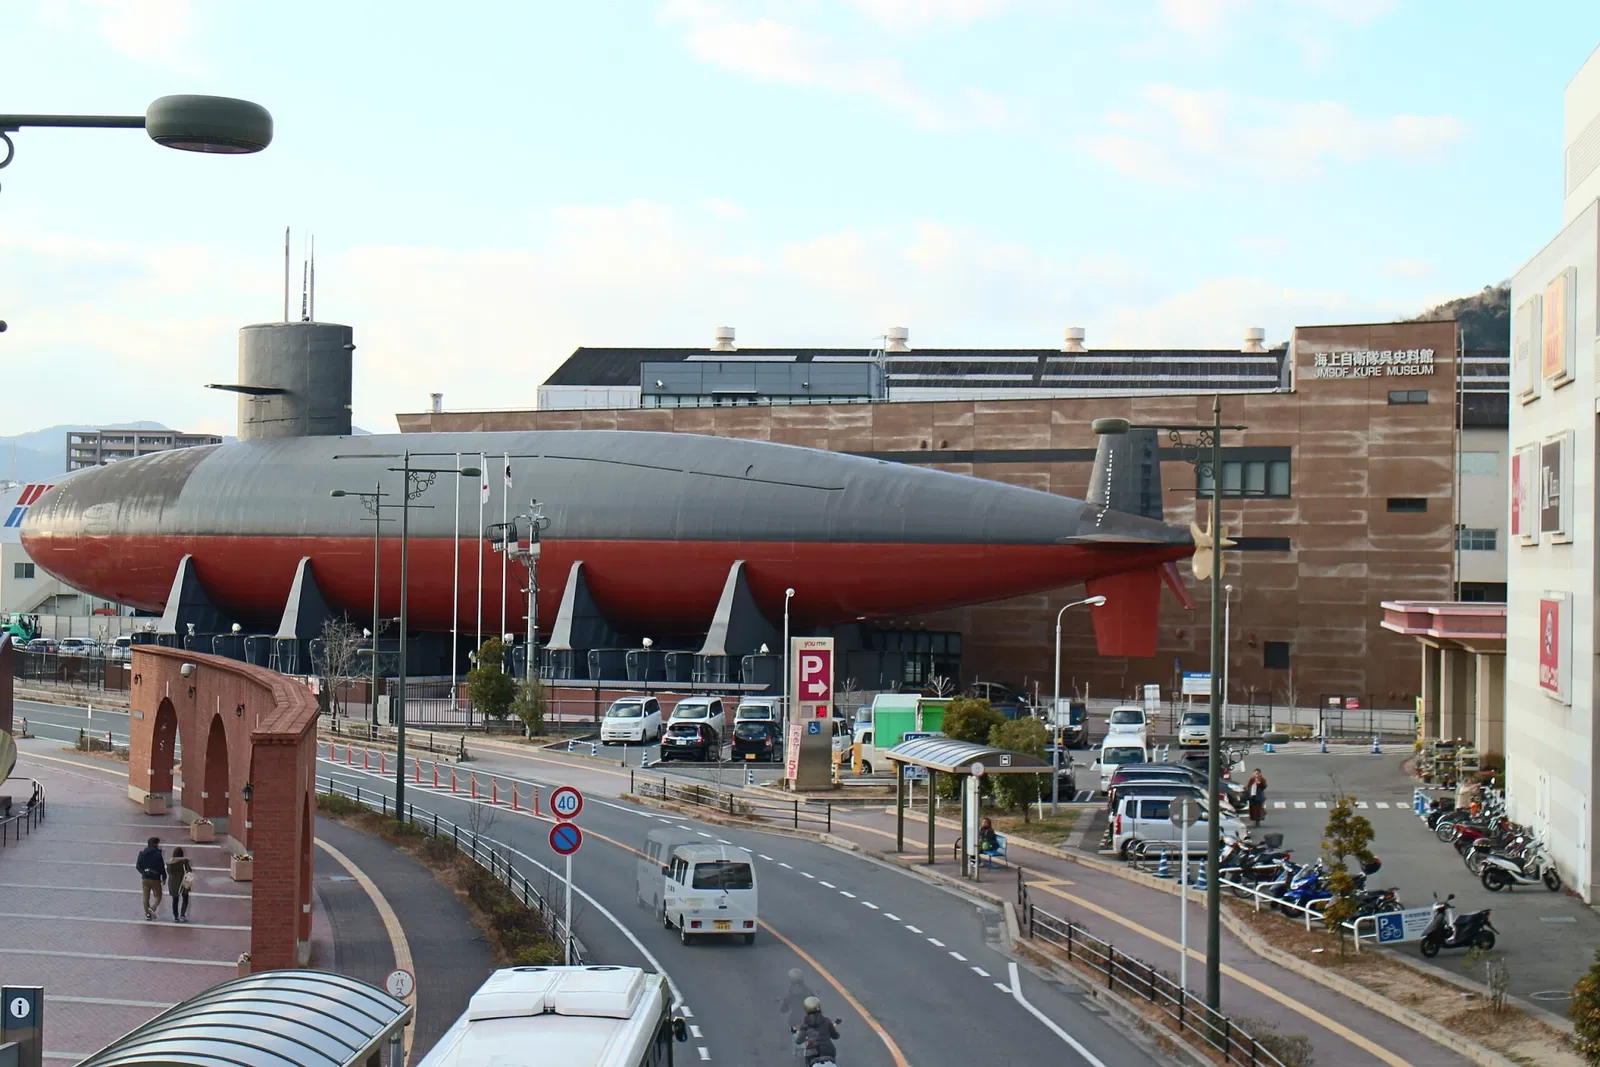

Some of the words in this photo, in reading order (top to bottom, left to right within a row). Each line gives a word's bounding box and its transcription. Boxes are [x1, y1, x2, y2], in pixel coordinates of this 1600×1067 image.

[1314, 349, 1434, 367] 海上自衛隊呉史料館
[1314, 367, 1349, 378] JMSDF
[1353, 366, 1382, 377] KURE
[1386, 365, 1434, 376] MUSEUM
[801, 655, 823, 682] P
[558, 796, 575, 810] 40
[1380, 918, 1389, 929] P
